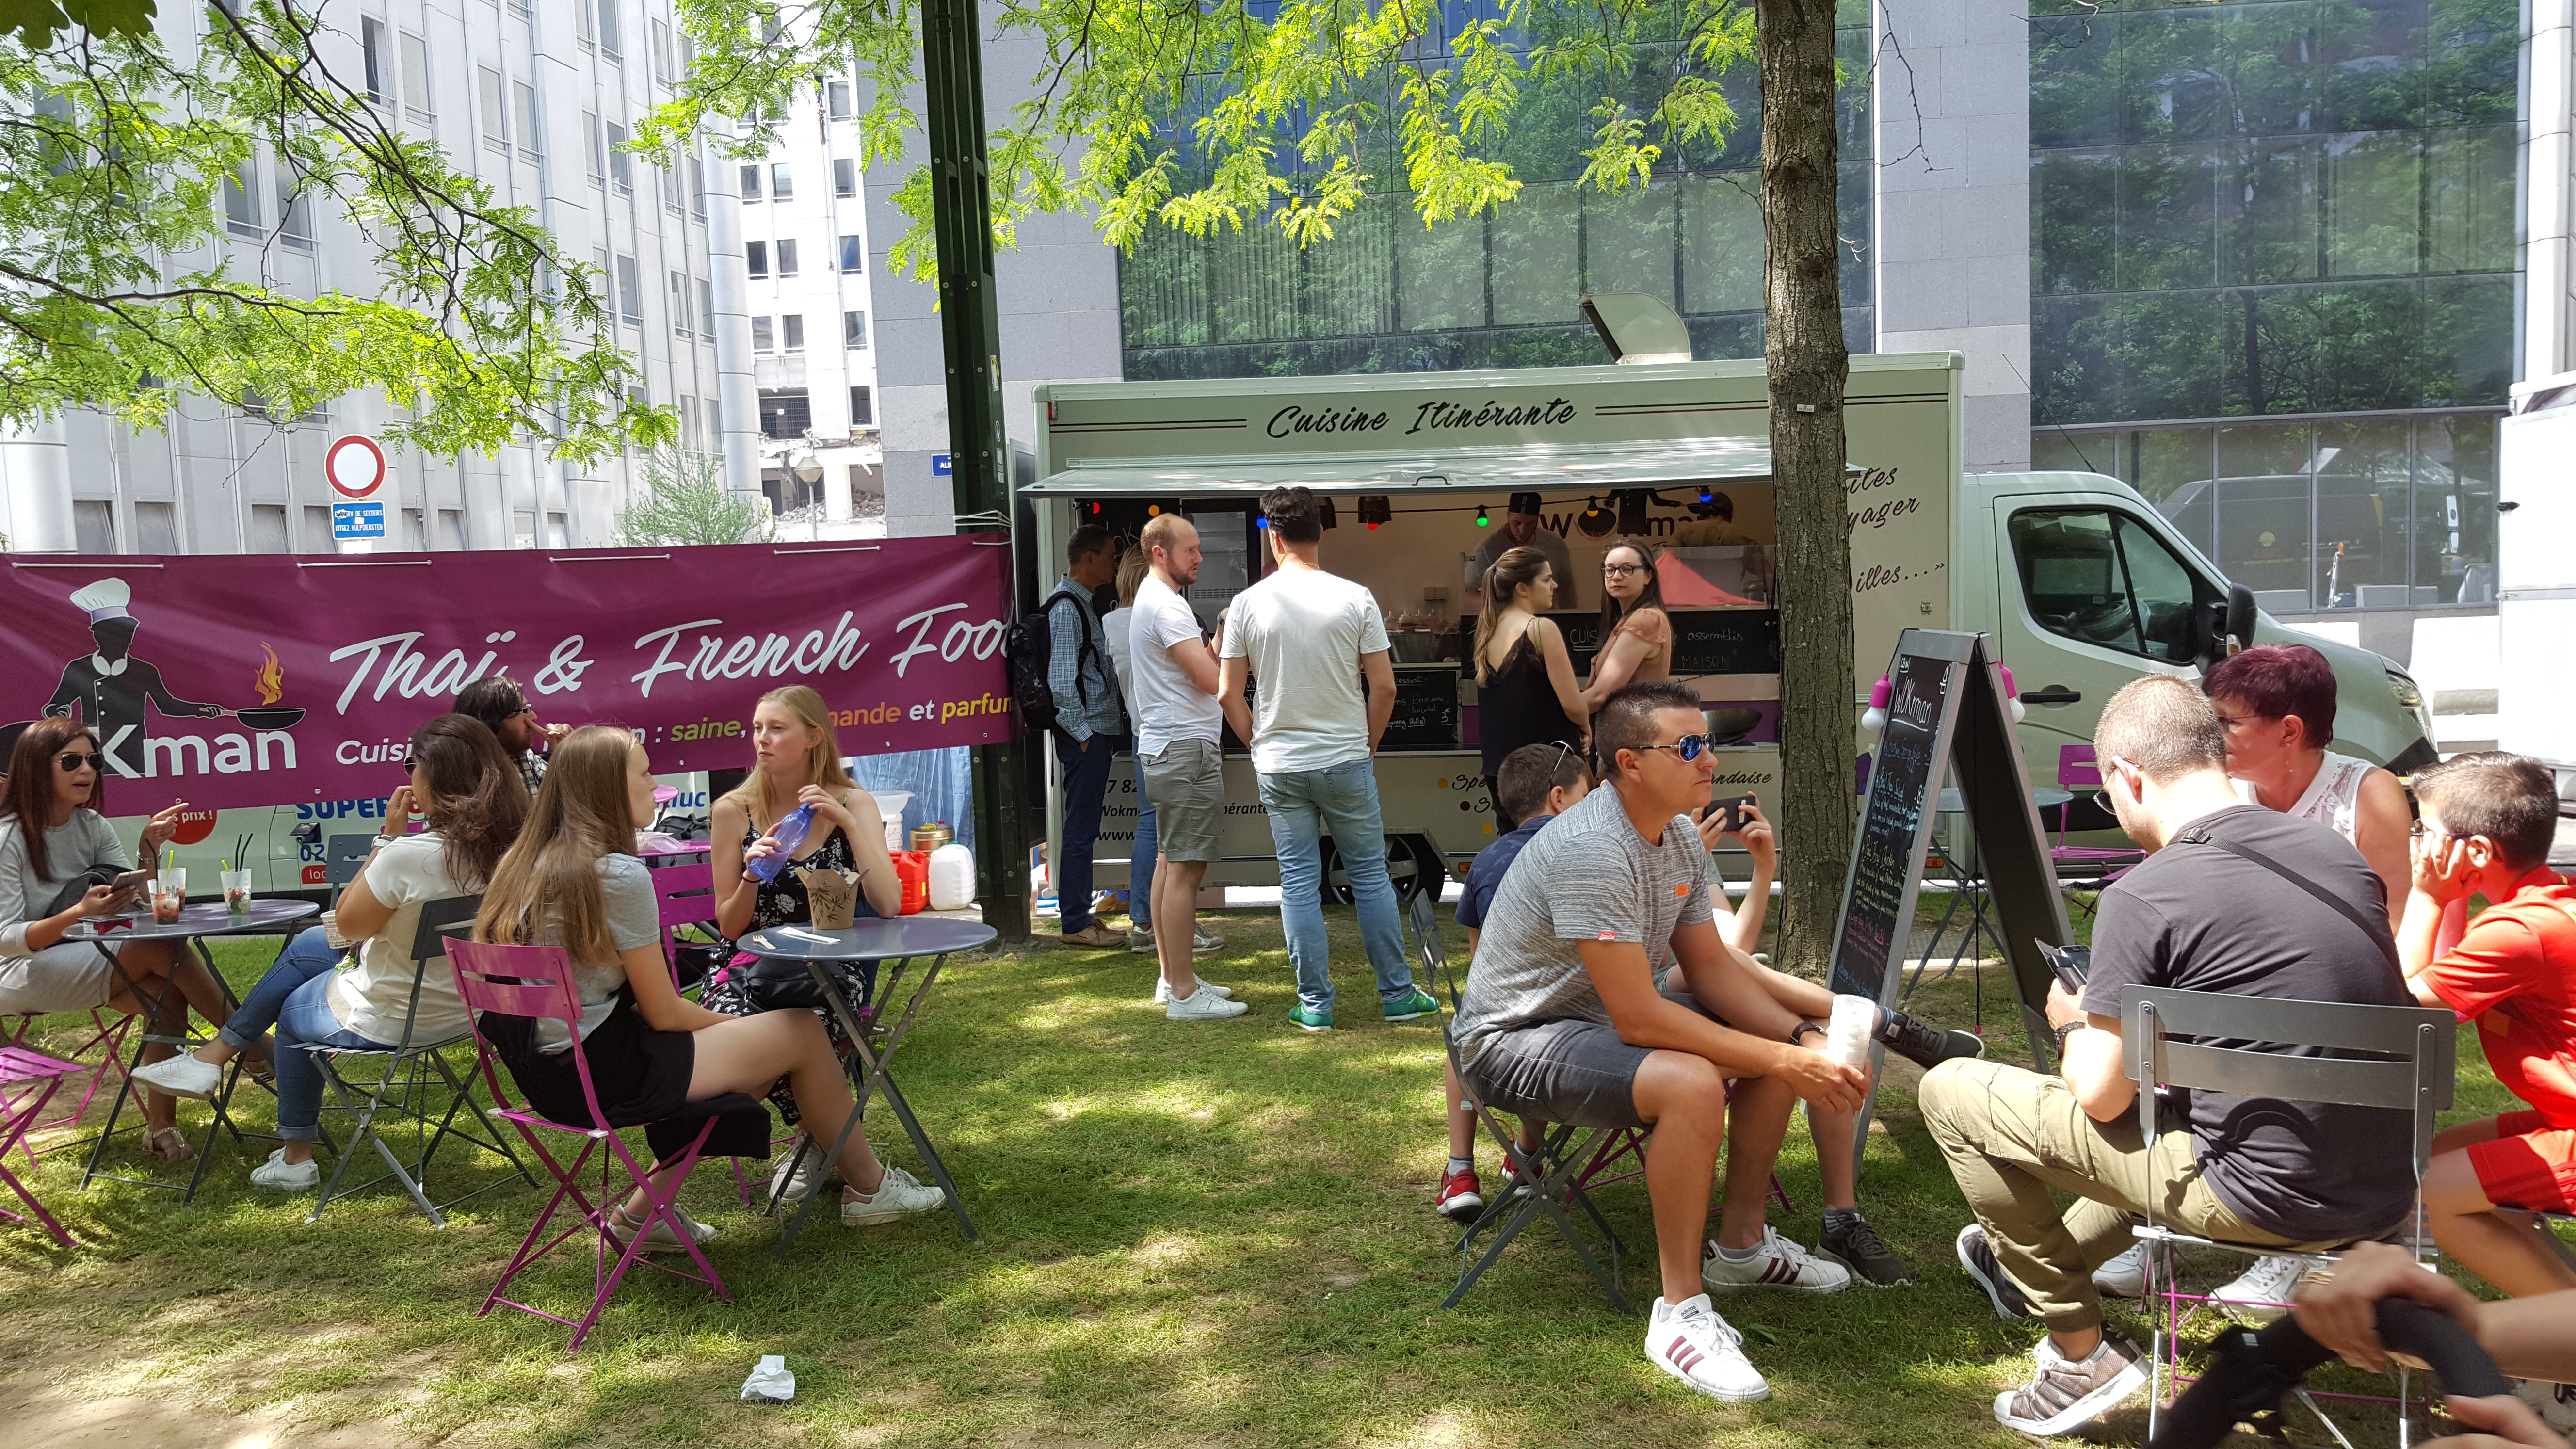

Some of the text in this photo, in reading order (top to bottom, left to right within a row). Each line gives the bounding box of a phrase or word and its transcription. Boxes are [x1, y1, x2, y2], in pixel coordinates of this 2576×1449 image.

[1266, 397, 1577, 438] Cuisine Itinérante
[1848, 498, 1920, 535] yager
[1856, 564, 1928, 593] illes...
[330, 630, 516, 715] Thaï
[534, 634, 595, 695] &
[631, 610, 870, 699] French
[336, 737, 414, 765] Cuisi
[670, 716, 746, 742] saine,
[909, 699, 935, 721] et
[182, 810, 207, 824] prix
[300, 844, 325, 862] 02
[309, 869, 326, 880] loc
[1680, 1305, 1696, 1317] adidas
